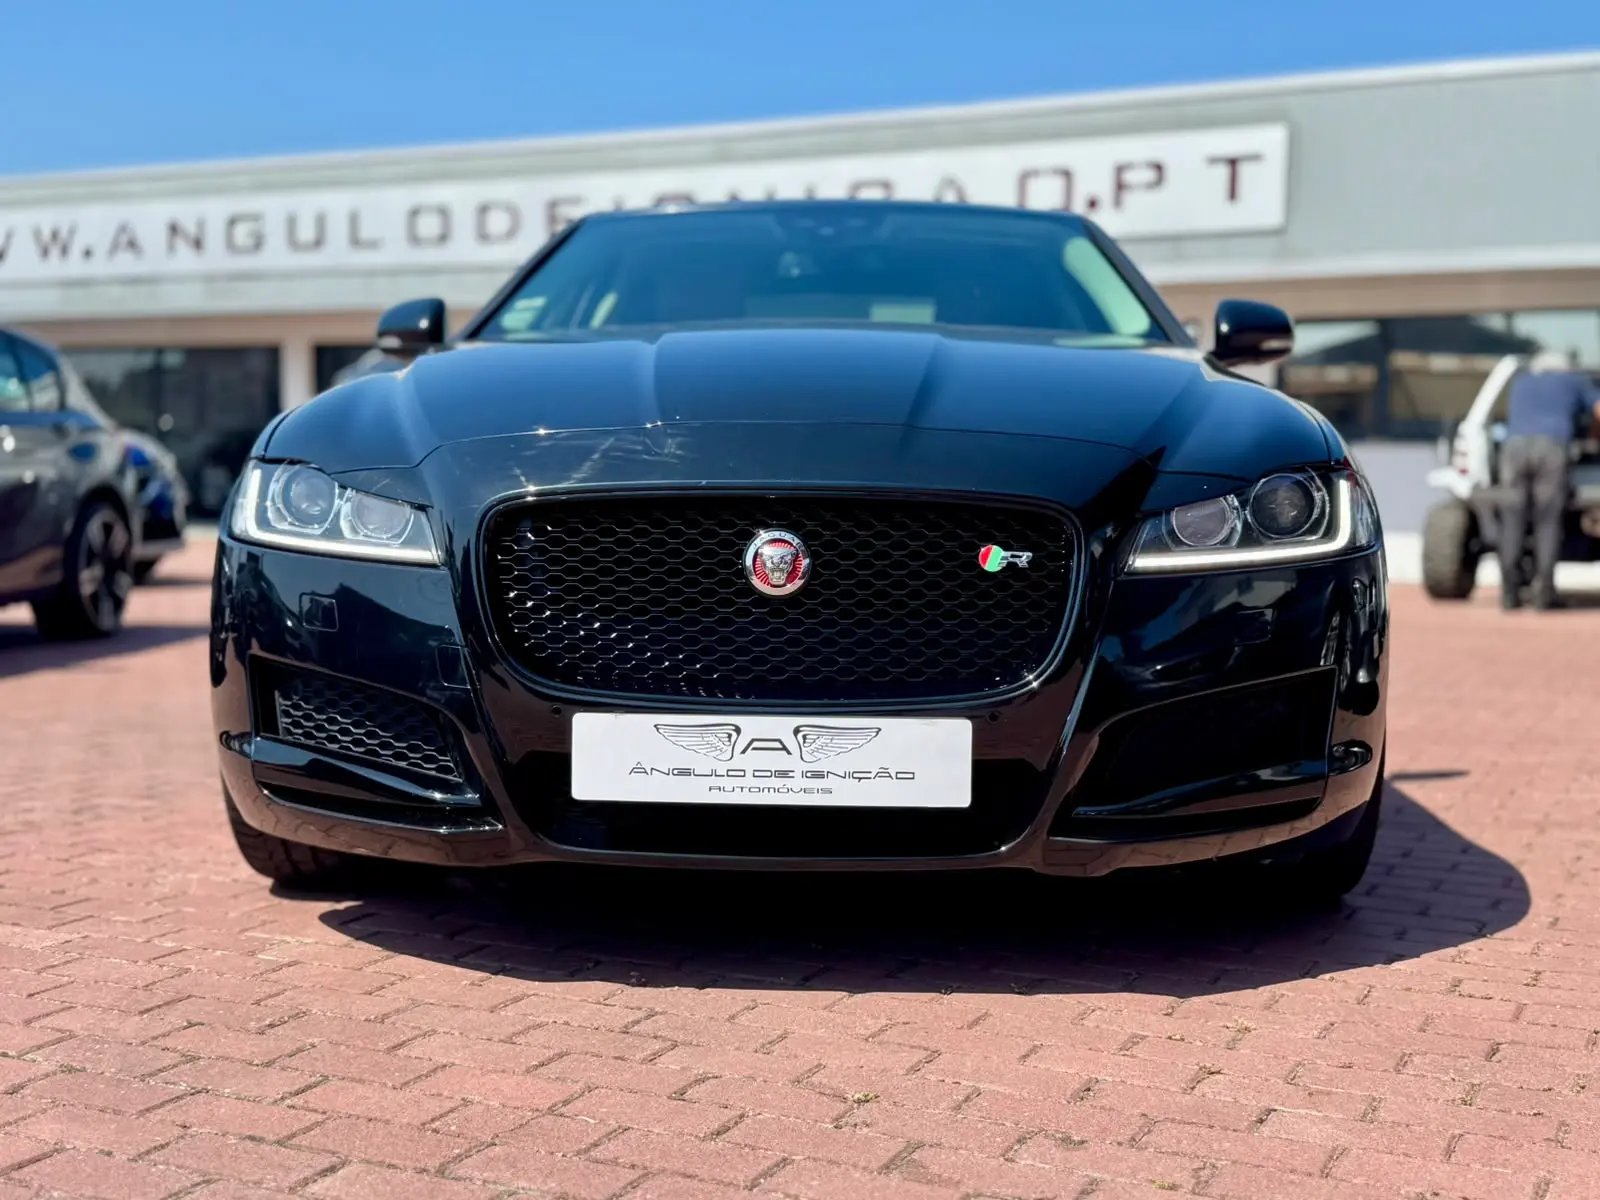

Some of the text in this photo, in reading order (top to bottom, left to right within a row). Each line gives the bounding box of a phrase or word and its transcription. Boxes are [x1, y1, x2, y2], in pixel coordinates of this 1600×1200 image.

[740, 738, 792, 755] A
[628, 761, 916, 782] ÂNGULO DE IGNIÇÃO
[708, 784, 833, 794] AUTOMÓVEIS
